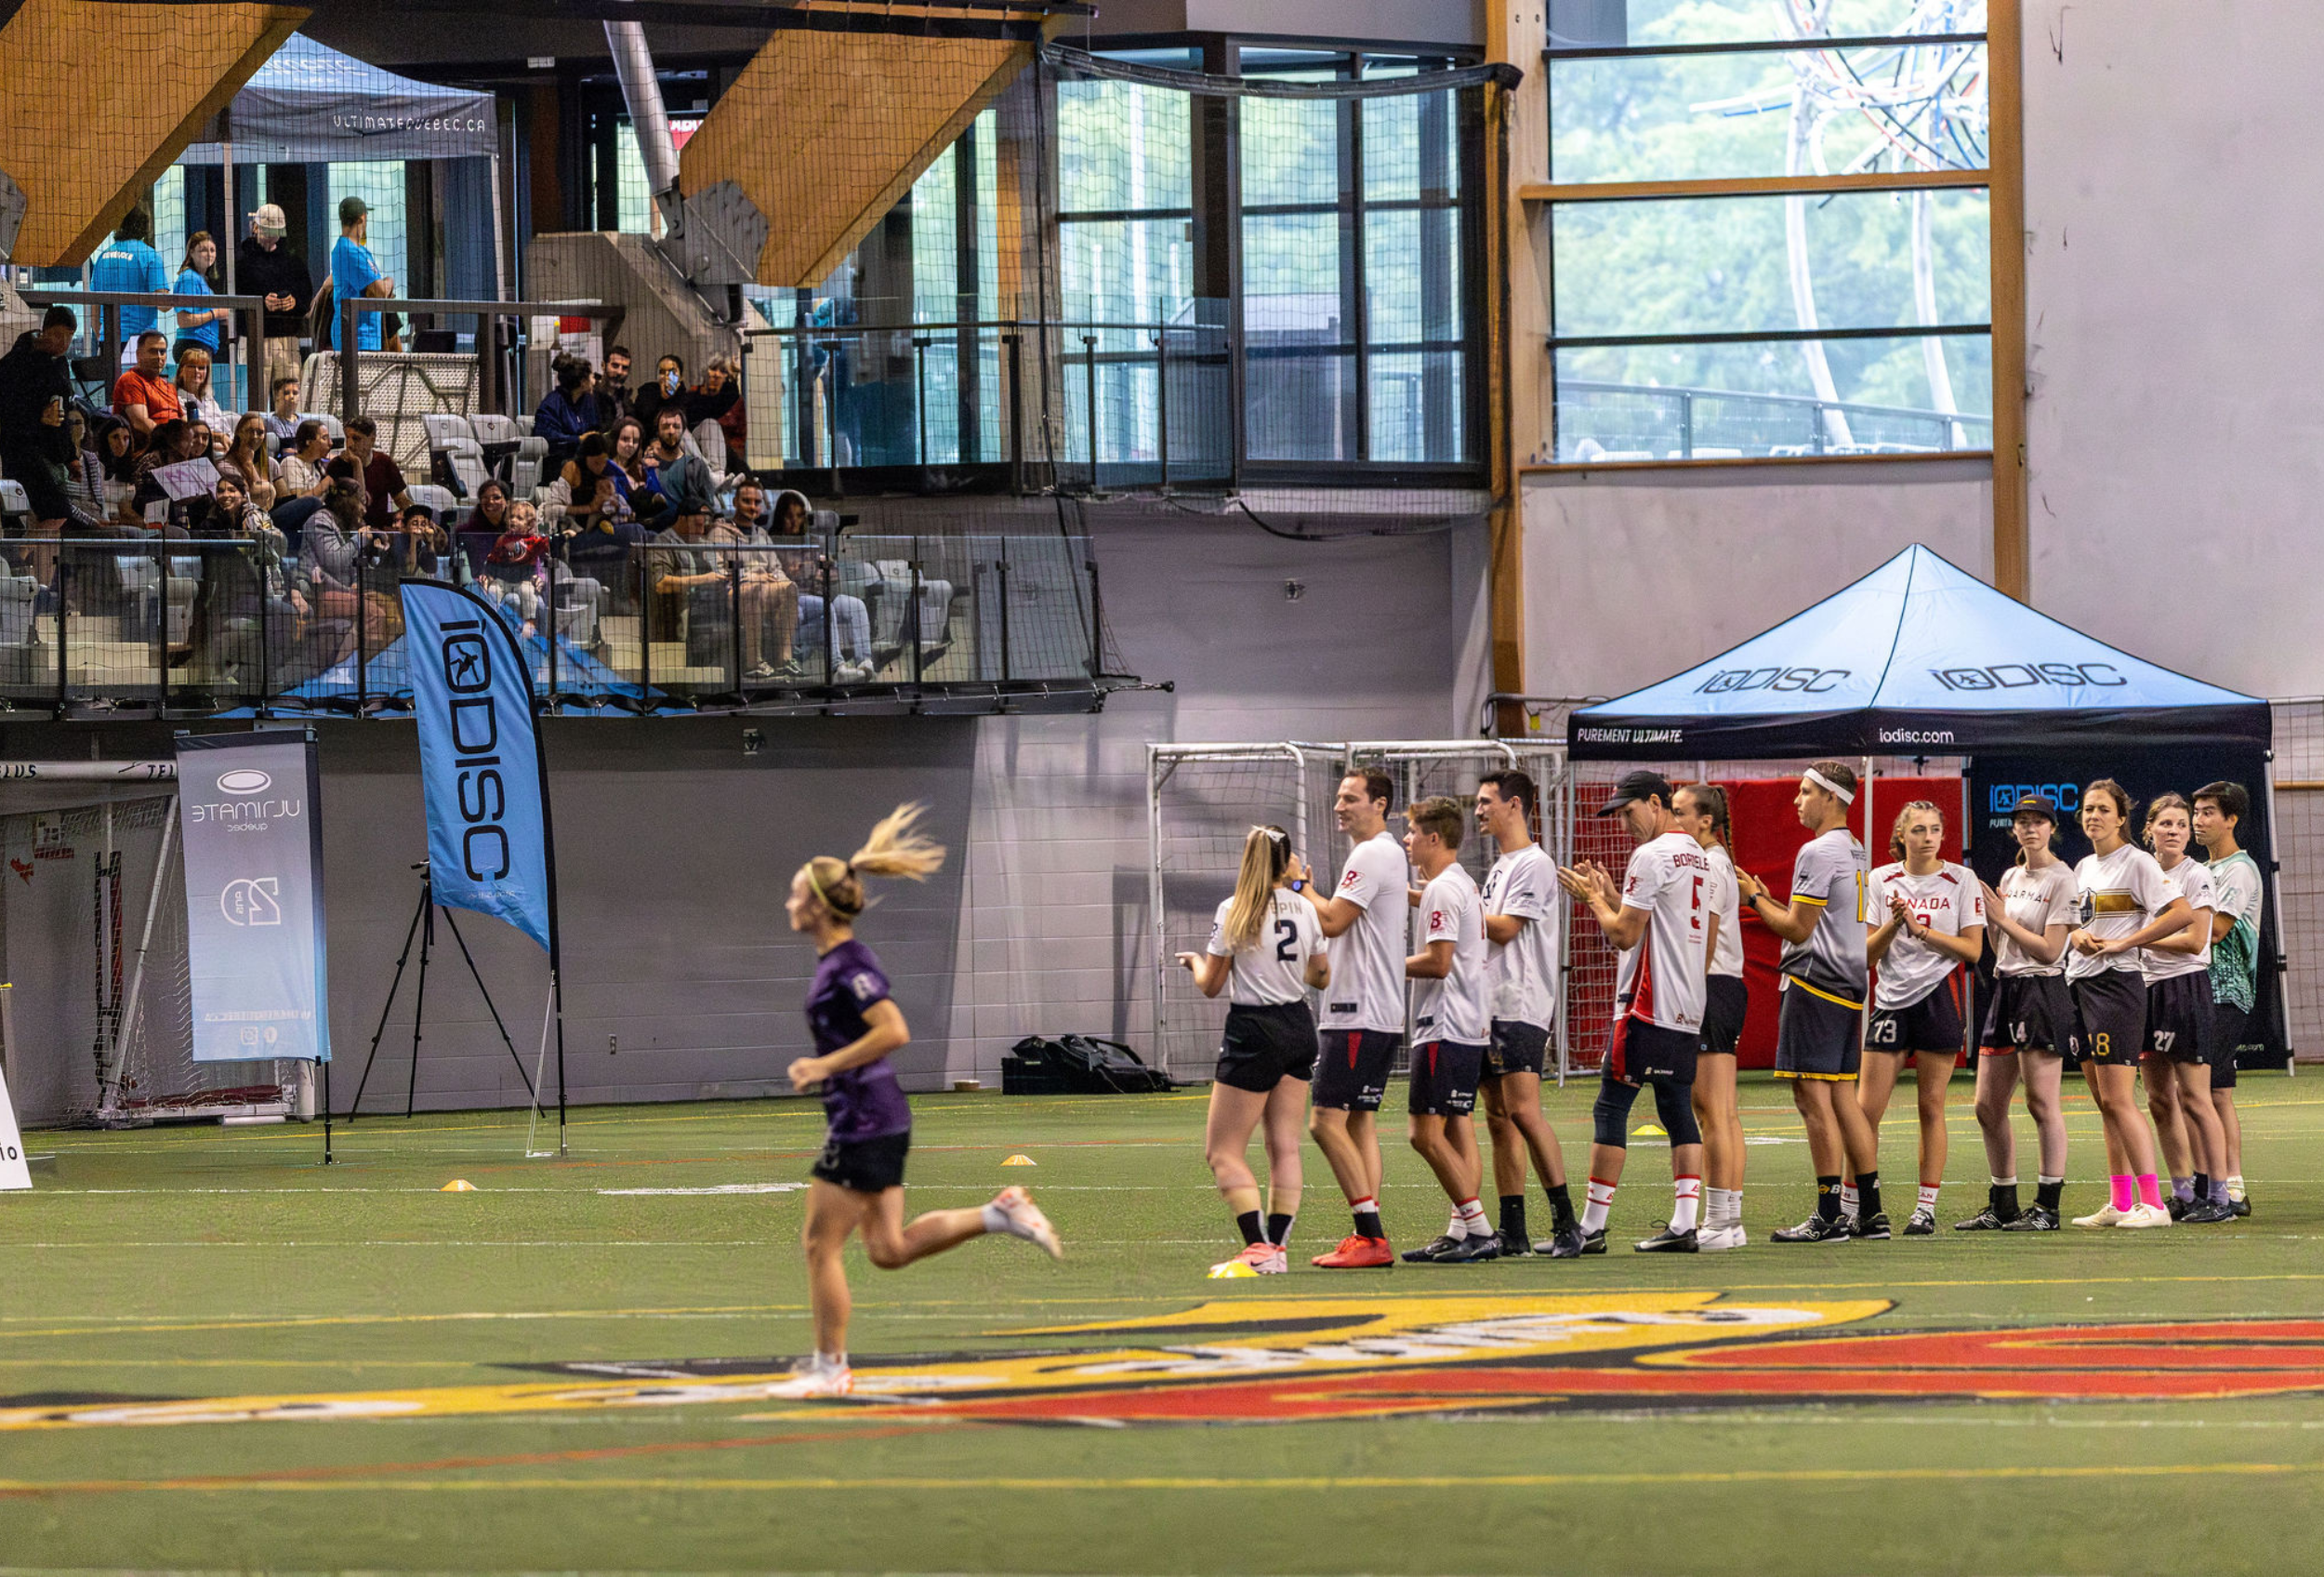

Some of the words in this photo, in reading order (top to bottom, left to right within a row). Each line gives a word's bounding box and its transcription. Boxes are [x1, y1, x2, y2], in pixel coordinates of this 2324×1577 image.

[1578, 728, 1631, 743] PUREMENT
[1879, 727, 1954, 744] iodisc.com
[1885, 895, 1950, 910] CNADA
[1274, 919, 1299, 962] 2
[1873, 1019, 1897, 1043] 73
[2153, 1029, 2175, 1053] 27
